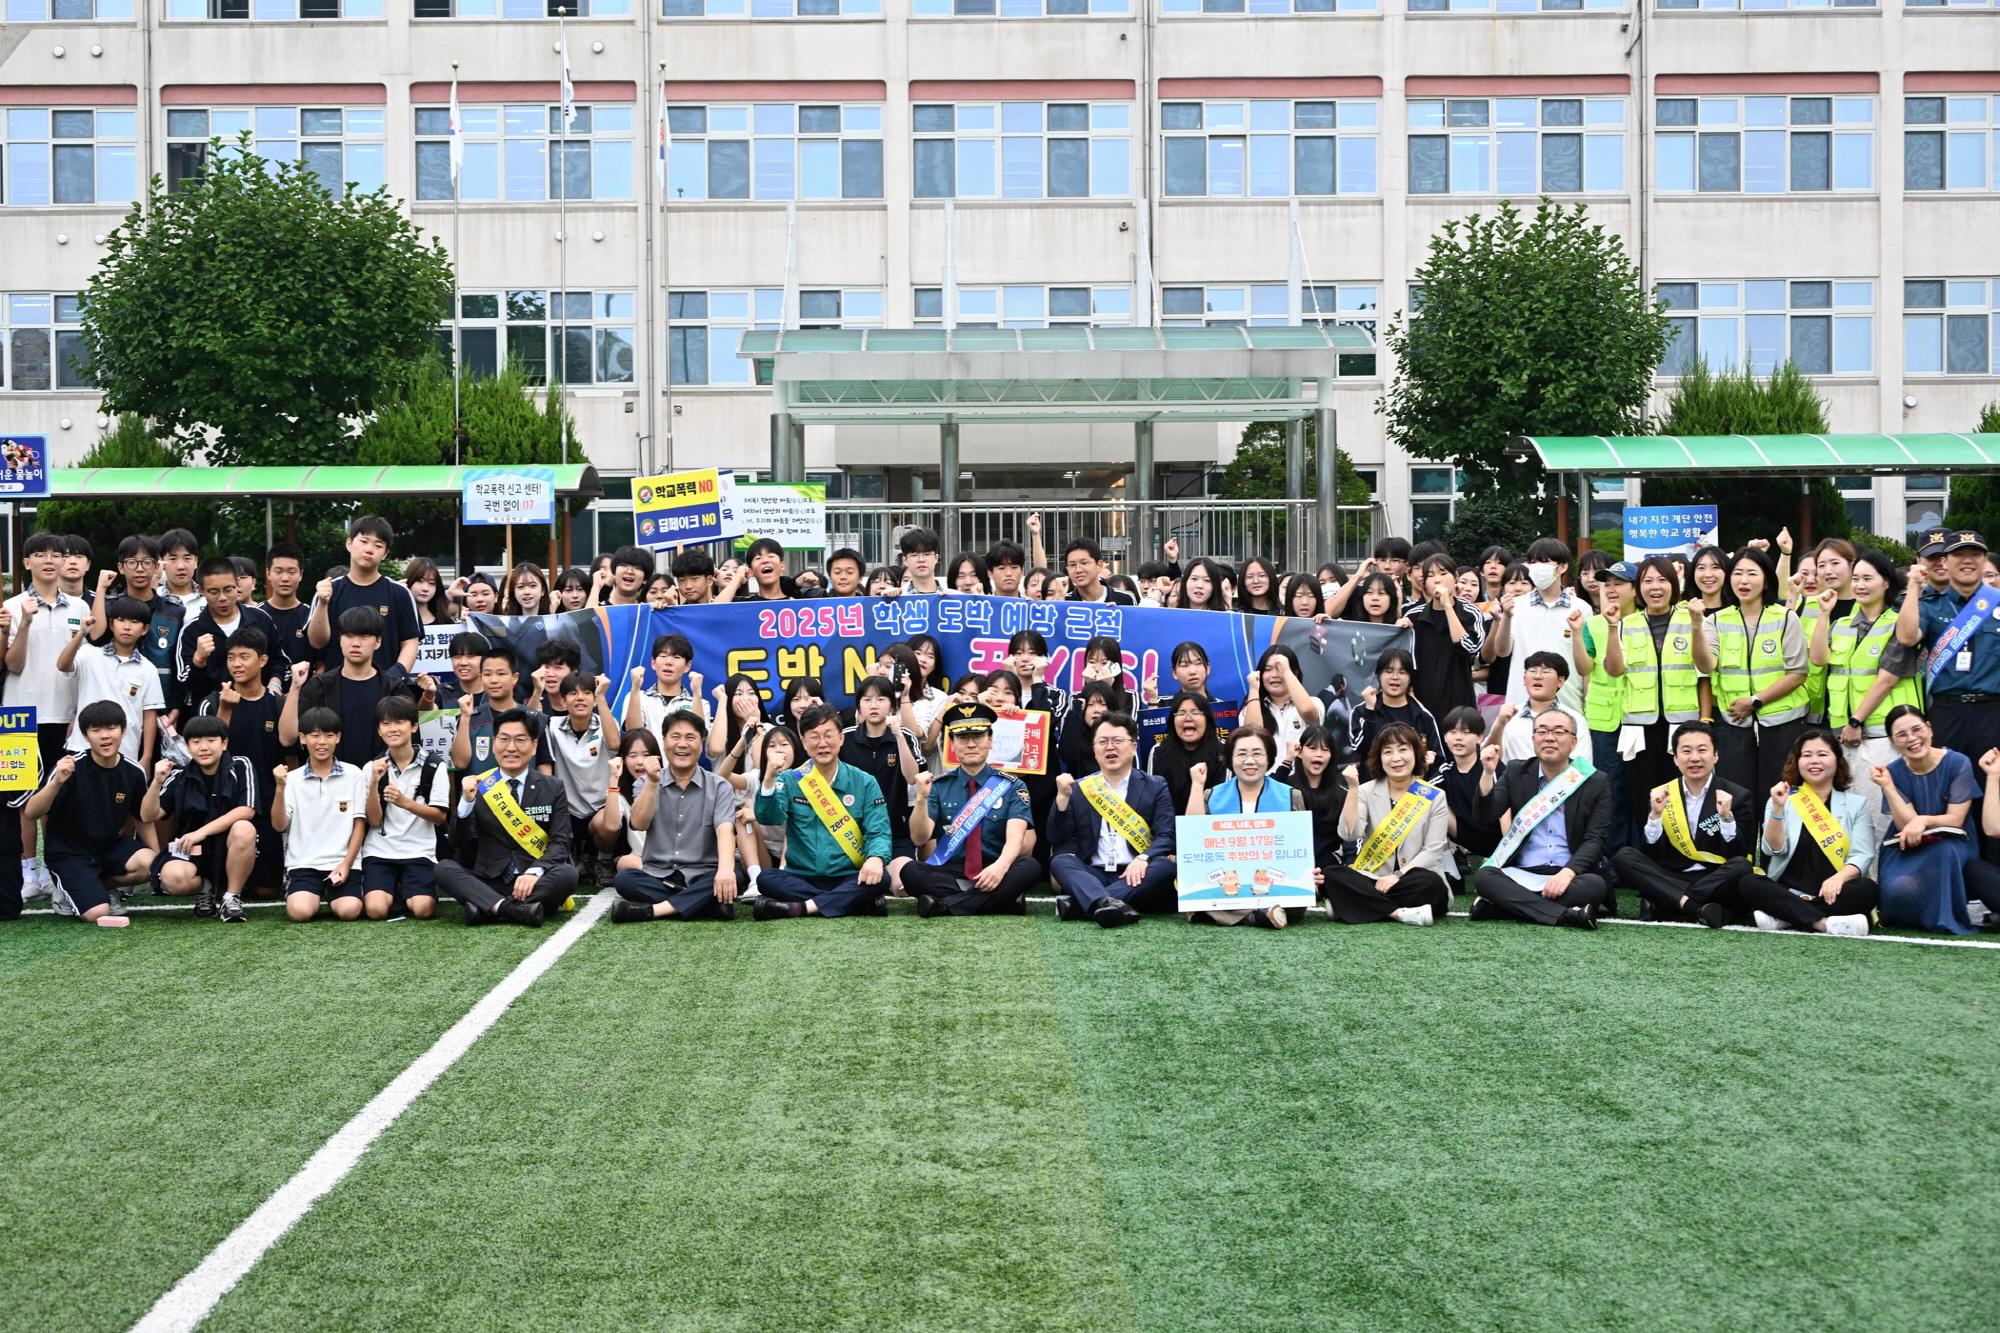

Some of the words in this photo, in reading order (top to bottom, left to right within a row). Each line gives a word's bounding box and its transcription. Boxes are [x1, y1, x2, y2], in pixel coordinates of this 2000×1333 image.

[16, 468, 43, 480] 물놀이
[476, 483, 505, 496] 학교폭력
[507, 483, 522, 495] 신고
[524, 482, 542, 495] 센터!
[655, 481, 697, 498] 학교폭력
[698, 479, 714, 493] NO
[484, 500, 500, 512] 국번
[503, 499, 520, 512] 없이
[522, 500, 534, 510] 117
[658, 515, 700, 533] 딥페이크
[701, 512, 717, 526] NO
[1628, 515, 1648, 525] 내가
[1650, 515, 1669, 524] 지킨
[1671, 514, 1691, 524] 계단
[1693, 513, 1713, 523] 안전
[1628, 528, 1658, 538] 행복한
[1660, 528, 1679, 538] 학교
[1682, 527, 1702, 538] 생활
[759, 603, 865, 638] 2025년
[872, 599, 930, 636] 학생
[937, 600, 994, 635] 도박
[1001, 601, 1058, 637] 예방
[1065, 606, 1122, 642] 근절
[425, 649, 451, 660] 지키
[0, 713, 30, 728] UT
[1143, 717, 1166, 726] 청소년을
[10, 760, 26, 769] 없는
[1549, 789, 1567, 805] 서로
[525, 805, 553, 815] 국회의원
[808, 778, 838, 817] 학교폭력
[829, 815, 851, 833] zero
[492, 792, 522, 828] 학교폭력
[517, 824, 532, 838] NO
[1518, 804, 1549, 836] 이해하고
[1801, 794, 1831, 832] 학교폭력
[1820, 831, 1844, 848] zero
[1219, 821, 1236, 829] 너도,
[1236, 820, 1253, 829] 나도,
[1204, 837, 1226, 848] 매년
[1228, 836, 1247, 847] 9월
[1249, 834, 1284, 847] 17일은
[1183, 852, 1225, 863] 도박중독
[1227, 850, 1259, 861] 추방의
[1262, 850, 1274, 860] 날
[1275, 848, 1308, 859] 입니다
